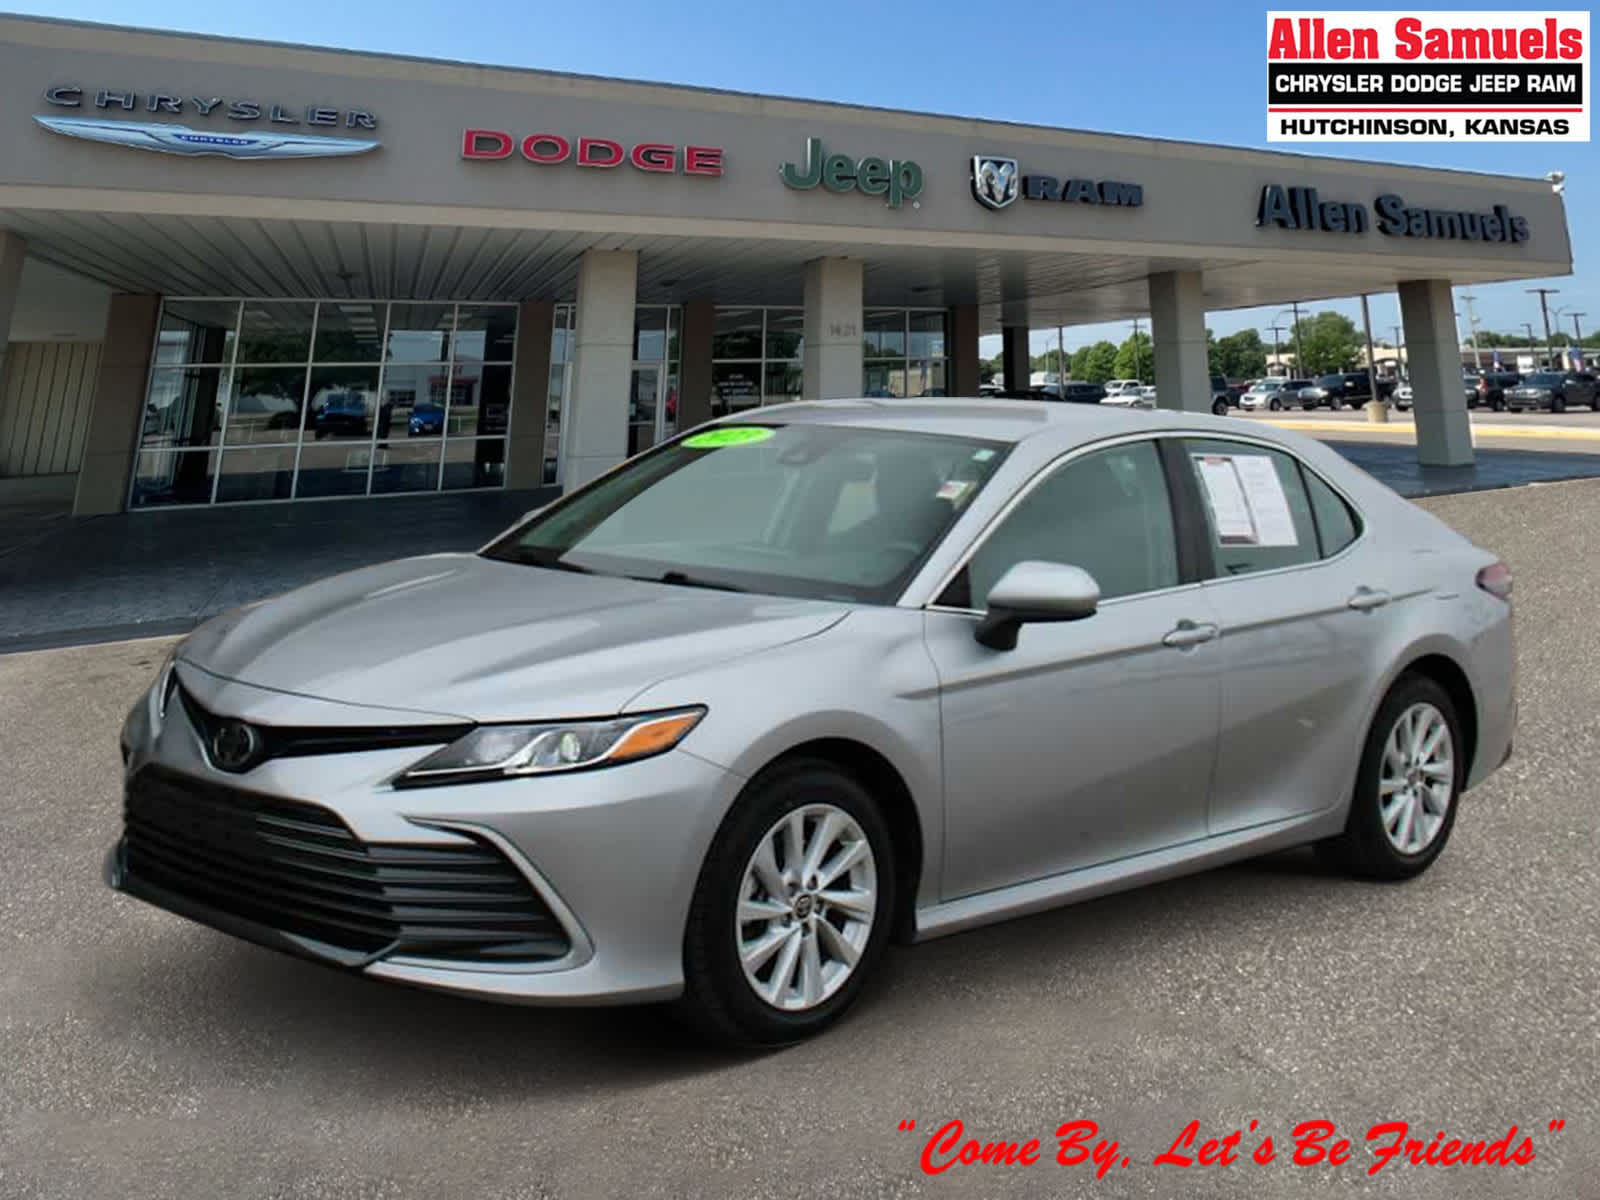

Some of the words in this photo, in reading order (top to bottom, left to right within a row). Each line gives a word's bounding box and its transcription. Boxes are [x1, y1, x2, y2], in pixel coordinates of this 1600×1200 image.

[44, 86, 378, 129] CHRYSLER
[461, 128, 725, 176] DODGE
[780, 137, 924, 208] Jeep
[1022, 175, 1144, 208] RAM
[1256, 184, 1369, 234] Allen
[1374, 193, 1531, 244] Samuels
